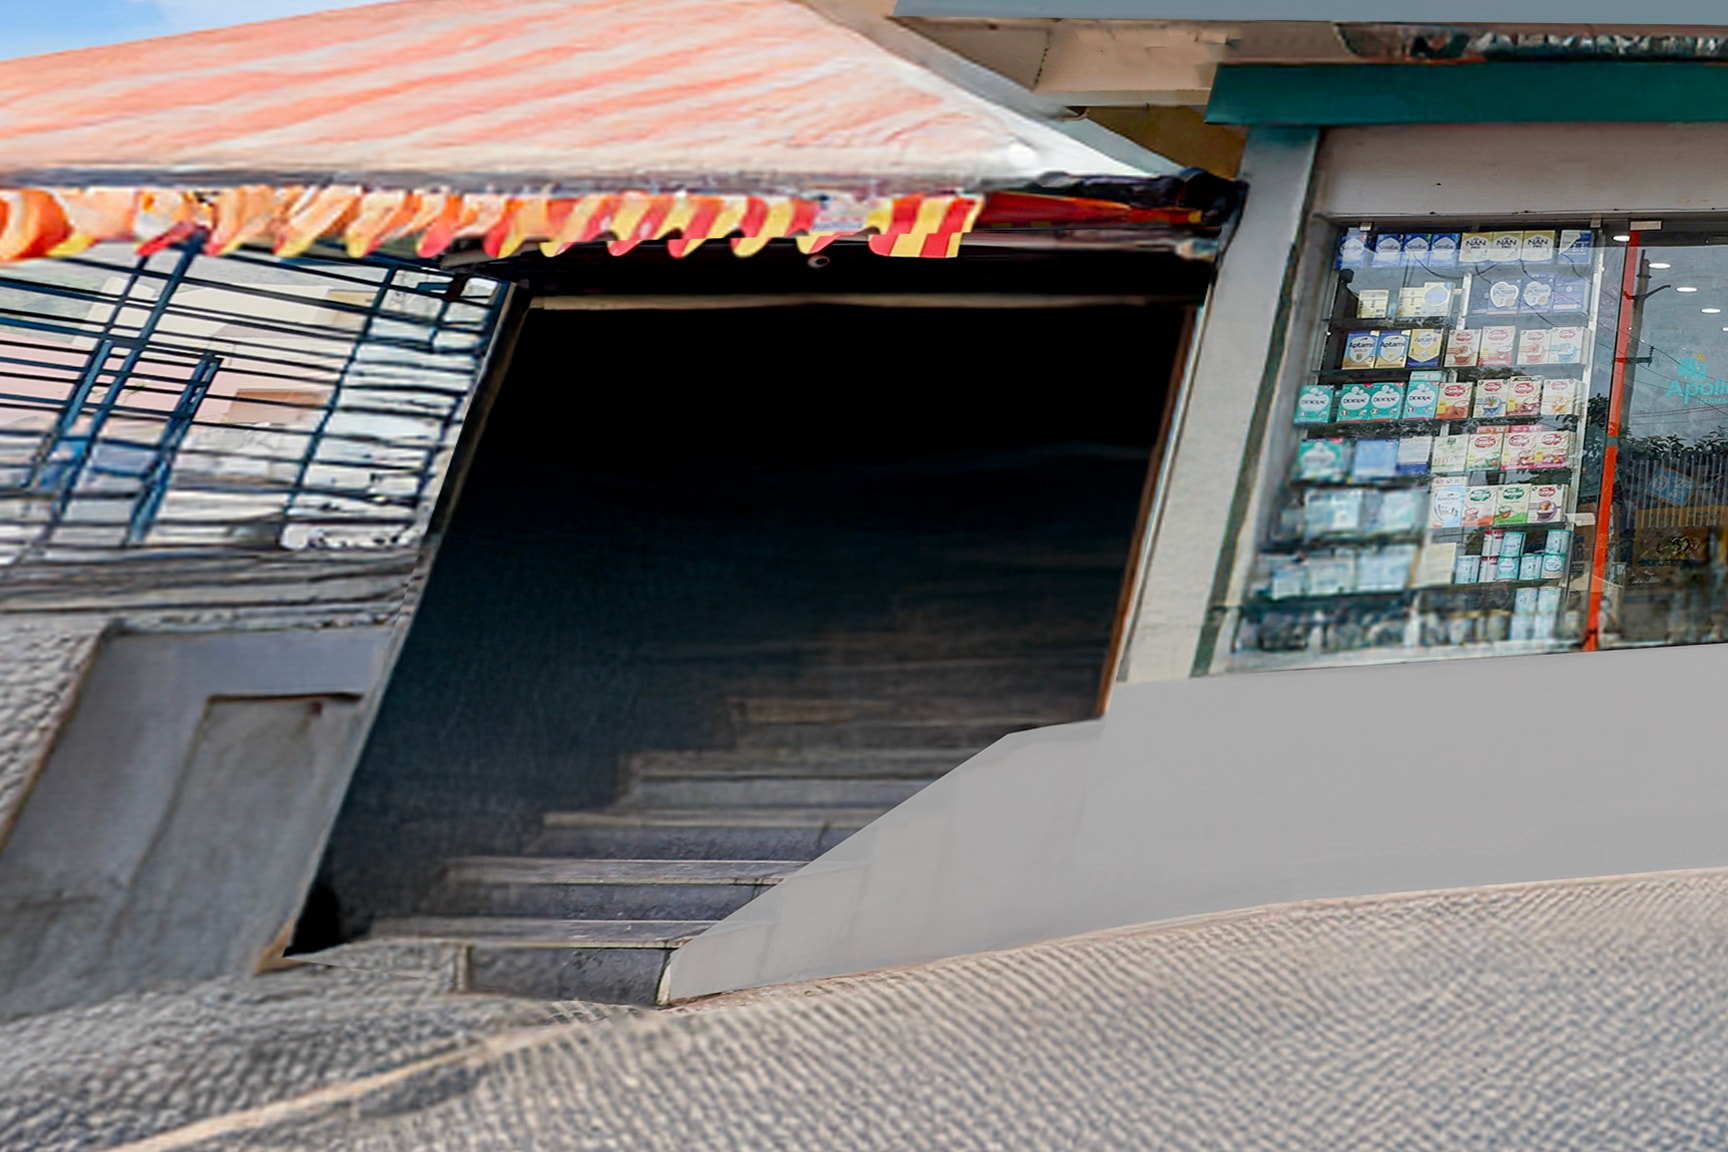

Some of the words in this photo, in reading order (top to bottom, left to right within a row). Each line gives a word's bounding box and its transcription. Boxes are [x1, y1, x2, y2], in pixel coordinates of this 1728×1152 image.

[1465, 239, 1487, 247] NAN
[1496, 238, 1517, 246] NAN
[1527, 238, 1548, 246] NAN
